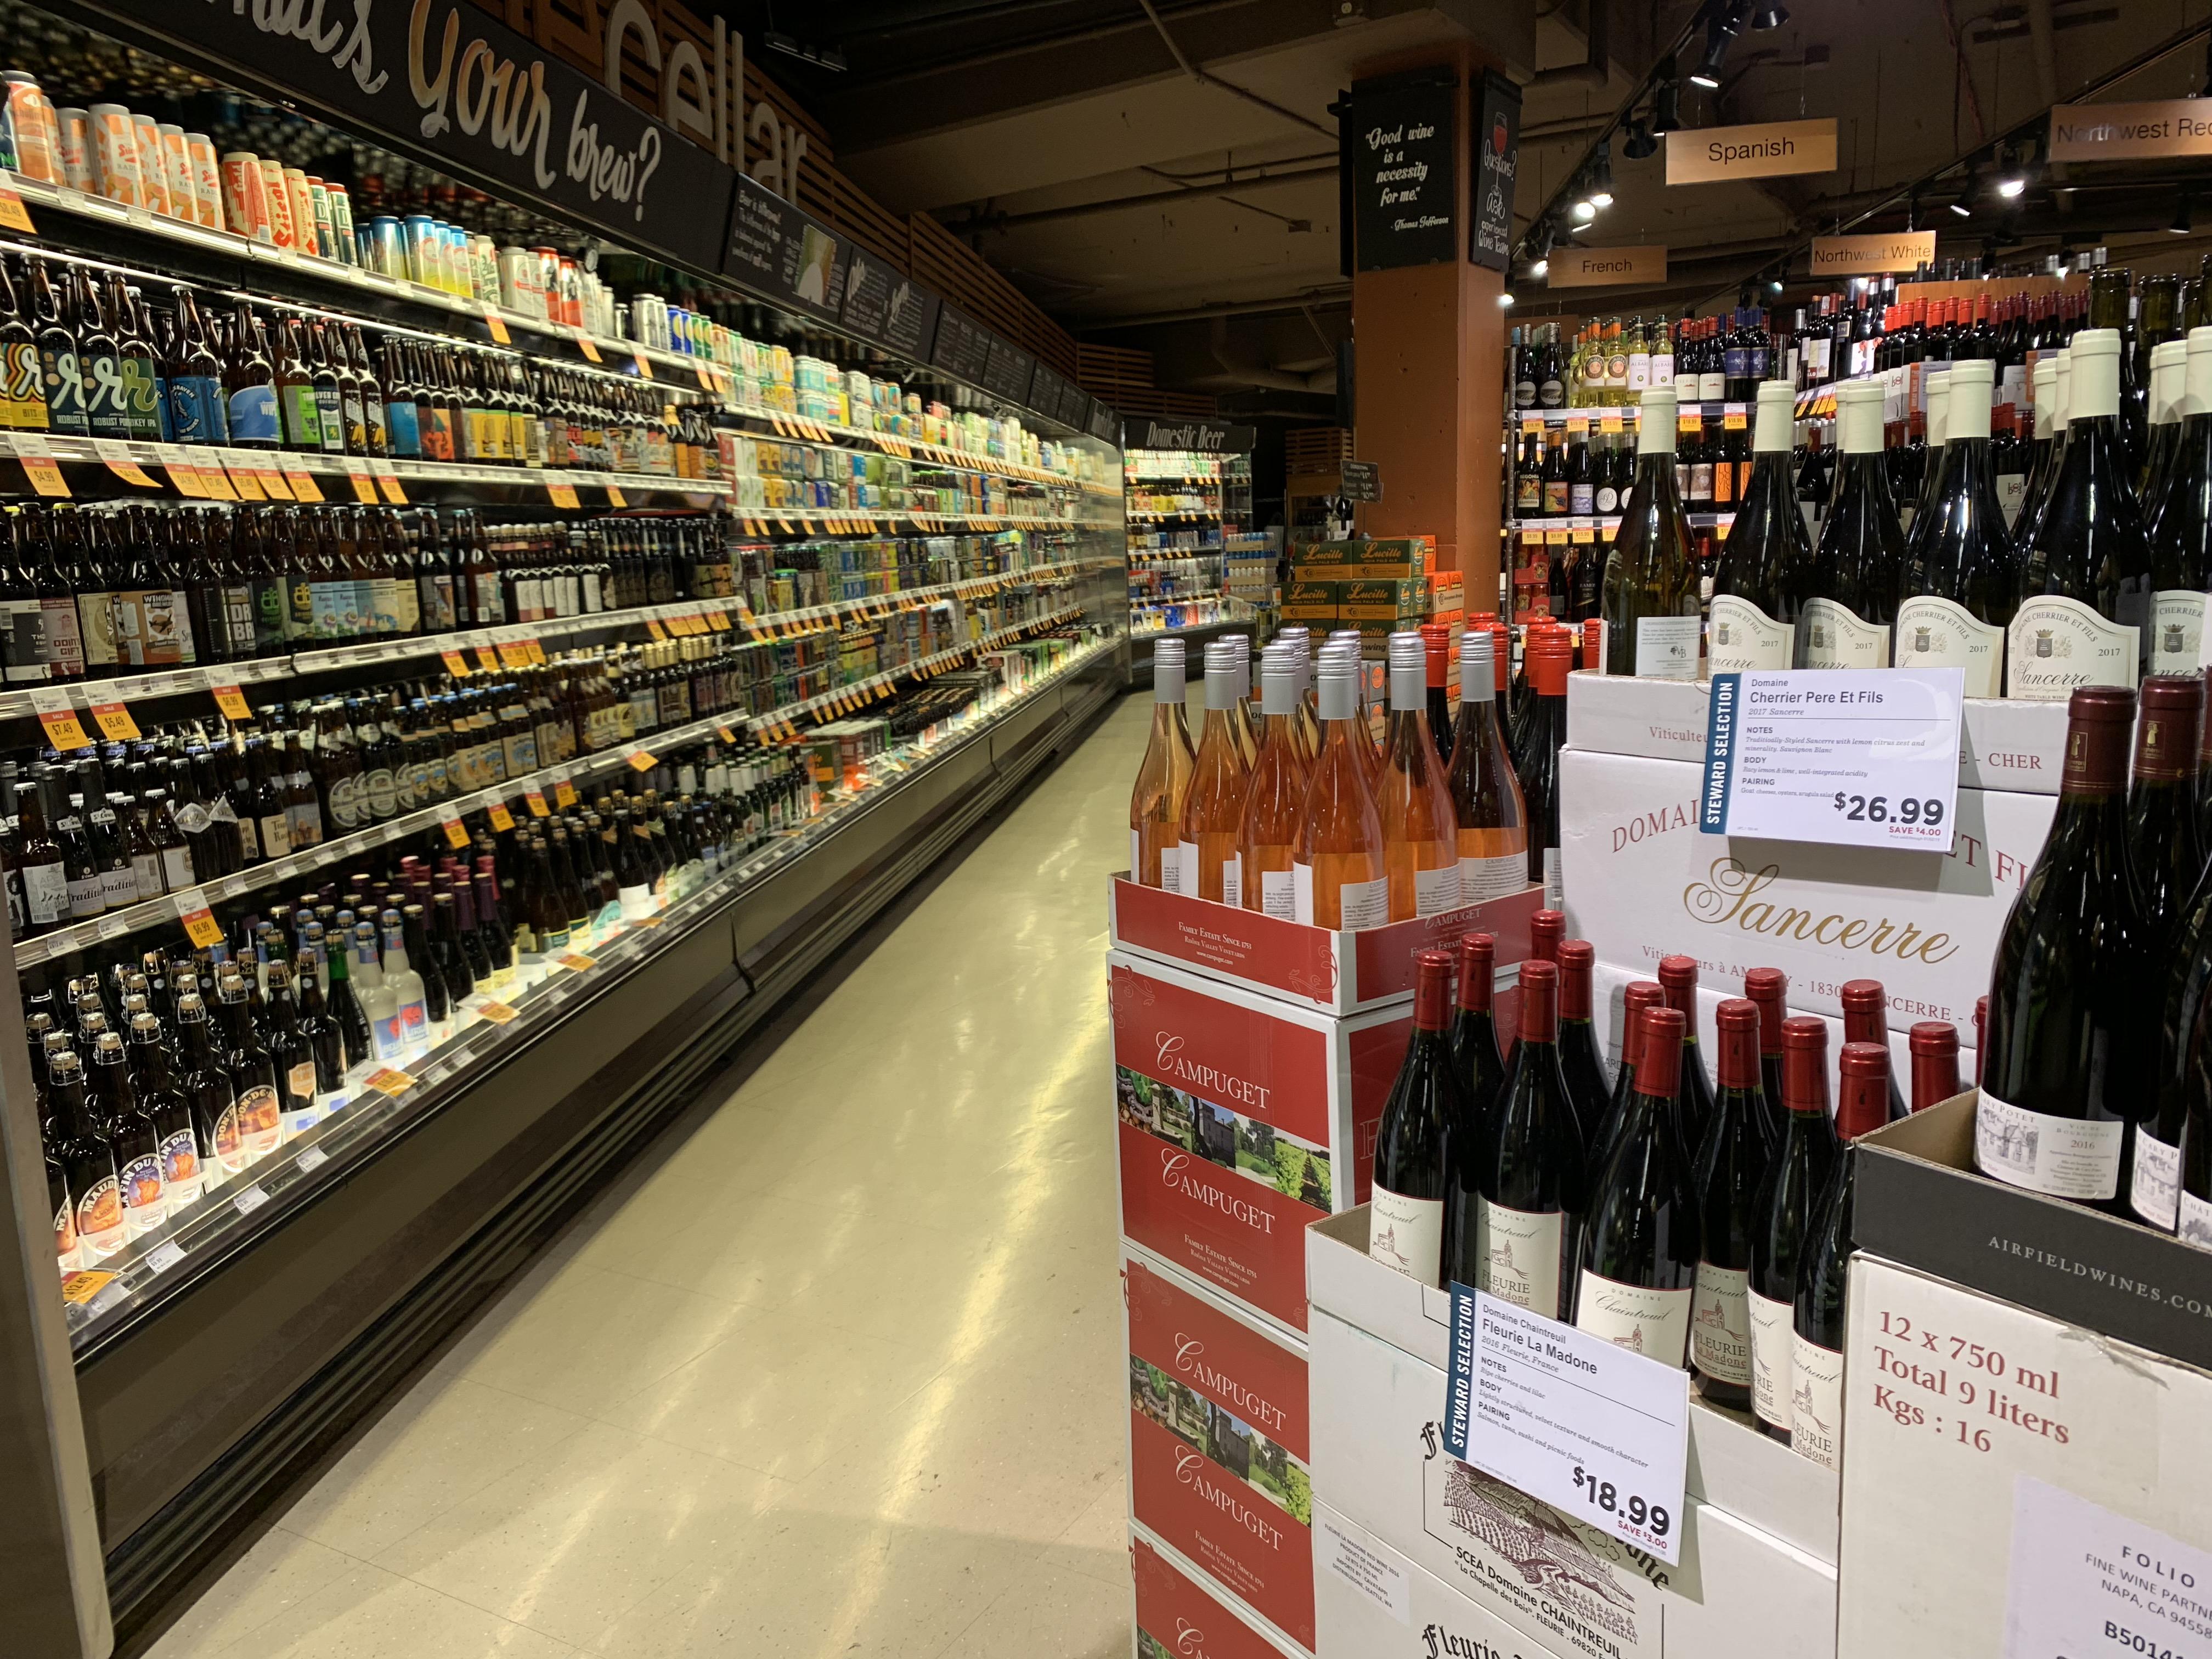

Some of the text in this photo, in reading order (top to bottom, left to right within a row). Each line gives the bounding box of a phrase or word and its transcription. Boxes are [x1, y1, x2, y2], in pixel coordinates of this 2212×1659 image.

[408, 0, 661, 221] Your brew?
[1408, 123, 1435, 140] wine
[1384, 149, 1403, 163] is a
[1485, 139, 1517, 181] Questions?
[1708, 138, 1795, 165] Spanish
[1376, 161, 1428, 183] necessity
[1380, 187, 1398, 207] for
[1395, 216, 1449, 231] Thomas Jefferson
[1481, 220, 1508, 238] experienced
[1479, 229, 1510, 256] Wine Team
[1814, 244, 1931, 263] Northwest White
[1582, 258, 1633, 273] French
[57, 415, 81, 425] ROBUST
[93, 417, 117, 427] ROBUST
[1146, 421, 1195, 448] Domestic
[1197, 424, 1225, 450] Beer
[1304, 543, 1344, 561] Lucille
[1360, 541, 1402, 558] Lucille
[1288, 583, 1328, 600] Lucille
[1347, 582, 1389, 600] Lucille
[1912, 610, 1970, 640] CHERRIER ET FILS
[2159, 606, 2204, 619] CHERRIER
[2032, 611, 2098, 642] CHERRIER ET FILS
[60, 646, 80, 656] GIFT
[2098, 648, 2121, 657] 2017
[2014, 661, 2094, 686] Sancerre
[1750, 691, 1884, 703] Cherrier Pere Et Fils
[52, 723, 73, 736] $7.49
[105, 716, 126, 729] $5.49
[1713, 681, 1734, 757] SELECTION
[1845, 769, 1869, 778] acidity
[1989, 753, 2042, 770] CHER
[1706, 758, 1726, 825] STEWARD
[1833, 791, 1944, 826] $26.99
[1889, 826, 1941, 836] SAVE $4.00
[1425, 907, 1482, 929] CAMPUGET
[1684, 856, 1960, 965] Sancerre
[193, 921, 211, 934] $6.99
[1178, 921, 1240, 947] FAMILY ESTATE SINCE
[1156, 1031, 1270, 1109] CAMPUGET
[2000, 1104, 2036, 1124] POTET
[171, 1133, 188, 1146] DU
[2070, 1140, 2096, 1150] 2016
[134, 1159, 151, 1172] DU
[1160, 1148, 1276, 1234] CAMPUGET
[1205, 1244, 1246, 1273] ESTATE SINCE
[1482, 1269, 1530, 1294] FLEURIE
[1595, 1290, 1677, 1322] Chaintreuil
[1457, 1294, 1474, 1376] SELECTION
[1483, 1304, 1567, 1344] Domaine Chaintreuil
[1481, 1335, 1560, 1373] 2016 Fleurie, France
[1483, 1318, 1598, 1374] Fleurie La Madone
[1694, 1330, 1747, 1356] FLEURIE
[1880, 1311, 2060, 1399] 12 x 750 ml
[1481, 1356, 1508, 1373] NOTES
[1175, 1332, 1286, 1432] CAMPUGET
[1480, 1378, 1503, 1394] BODY
[1494, 1374, 1532, 1393] cherries and
[1874, 1345, 2069, 1444] Total 9 liters
[1451, 1378, 1470, 1448] STEWARD
[1478, 1401, 1510, 1421] PAIRING
[1874, 1384, 1992, 1453] Kgs 16
[1479, 1389, 1649, 1469] Lightly texture and smooth character
[1518, 1430, 1585, 1466] sushi and picnic foods
[1175, 1444, 1284, 1551] CAMPUGET
[1572, 1466, 1671, 1537] $18.99
[1617, 1520, 1641, 1538] SAVE
[1643, 1531, 1668, 1550] $3.00
[1324, 1523, 1341, 1538] FLEURIE
[1347, 1538, 1367, 1555] MADONE
[1367, 1551, 1376, 1562] RED
[1376, 1557, 1389, 1571] WINE
[1389, 1567, 1400, 1578] 2016
[1340, 1542, 1384, 1576] PRODUCT FRANCE
[2086, 1553, 2116, 1576] FINE
[2120, 1568, 2158, 1595] WINE
[2122, 1545, 2195, 1589] FOLIO
[1456, 1546, 1622, 1659] SCEA Domaine CHAINTREUIL
[1460, 1564, 1596, 1657] La Chapelle des FLEURIE 69820
[2102, 1579, 2212, 1639] NAPA, CA 94558
